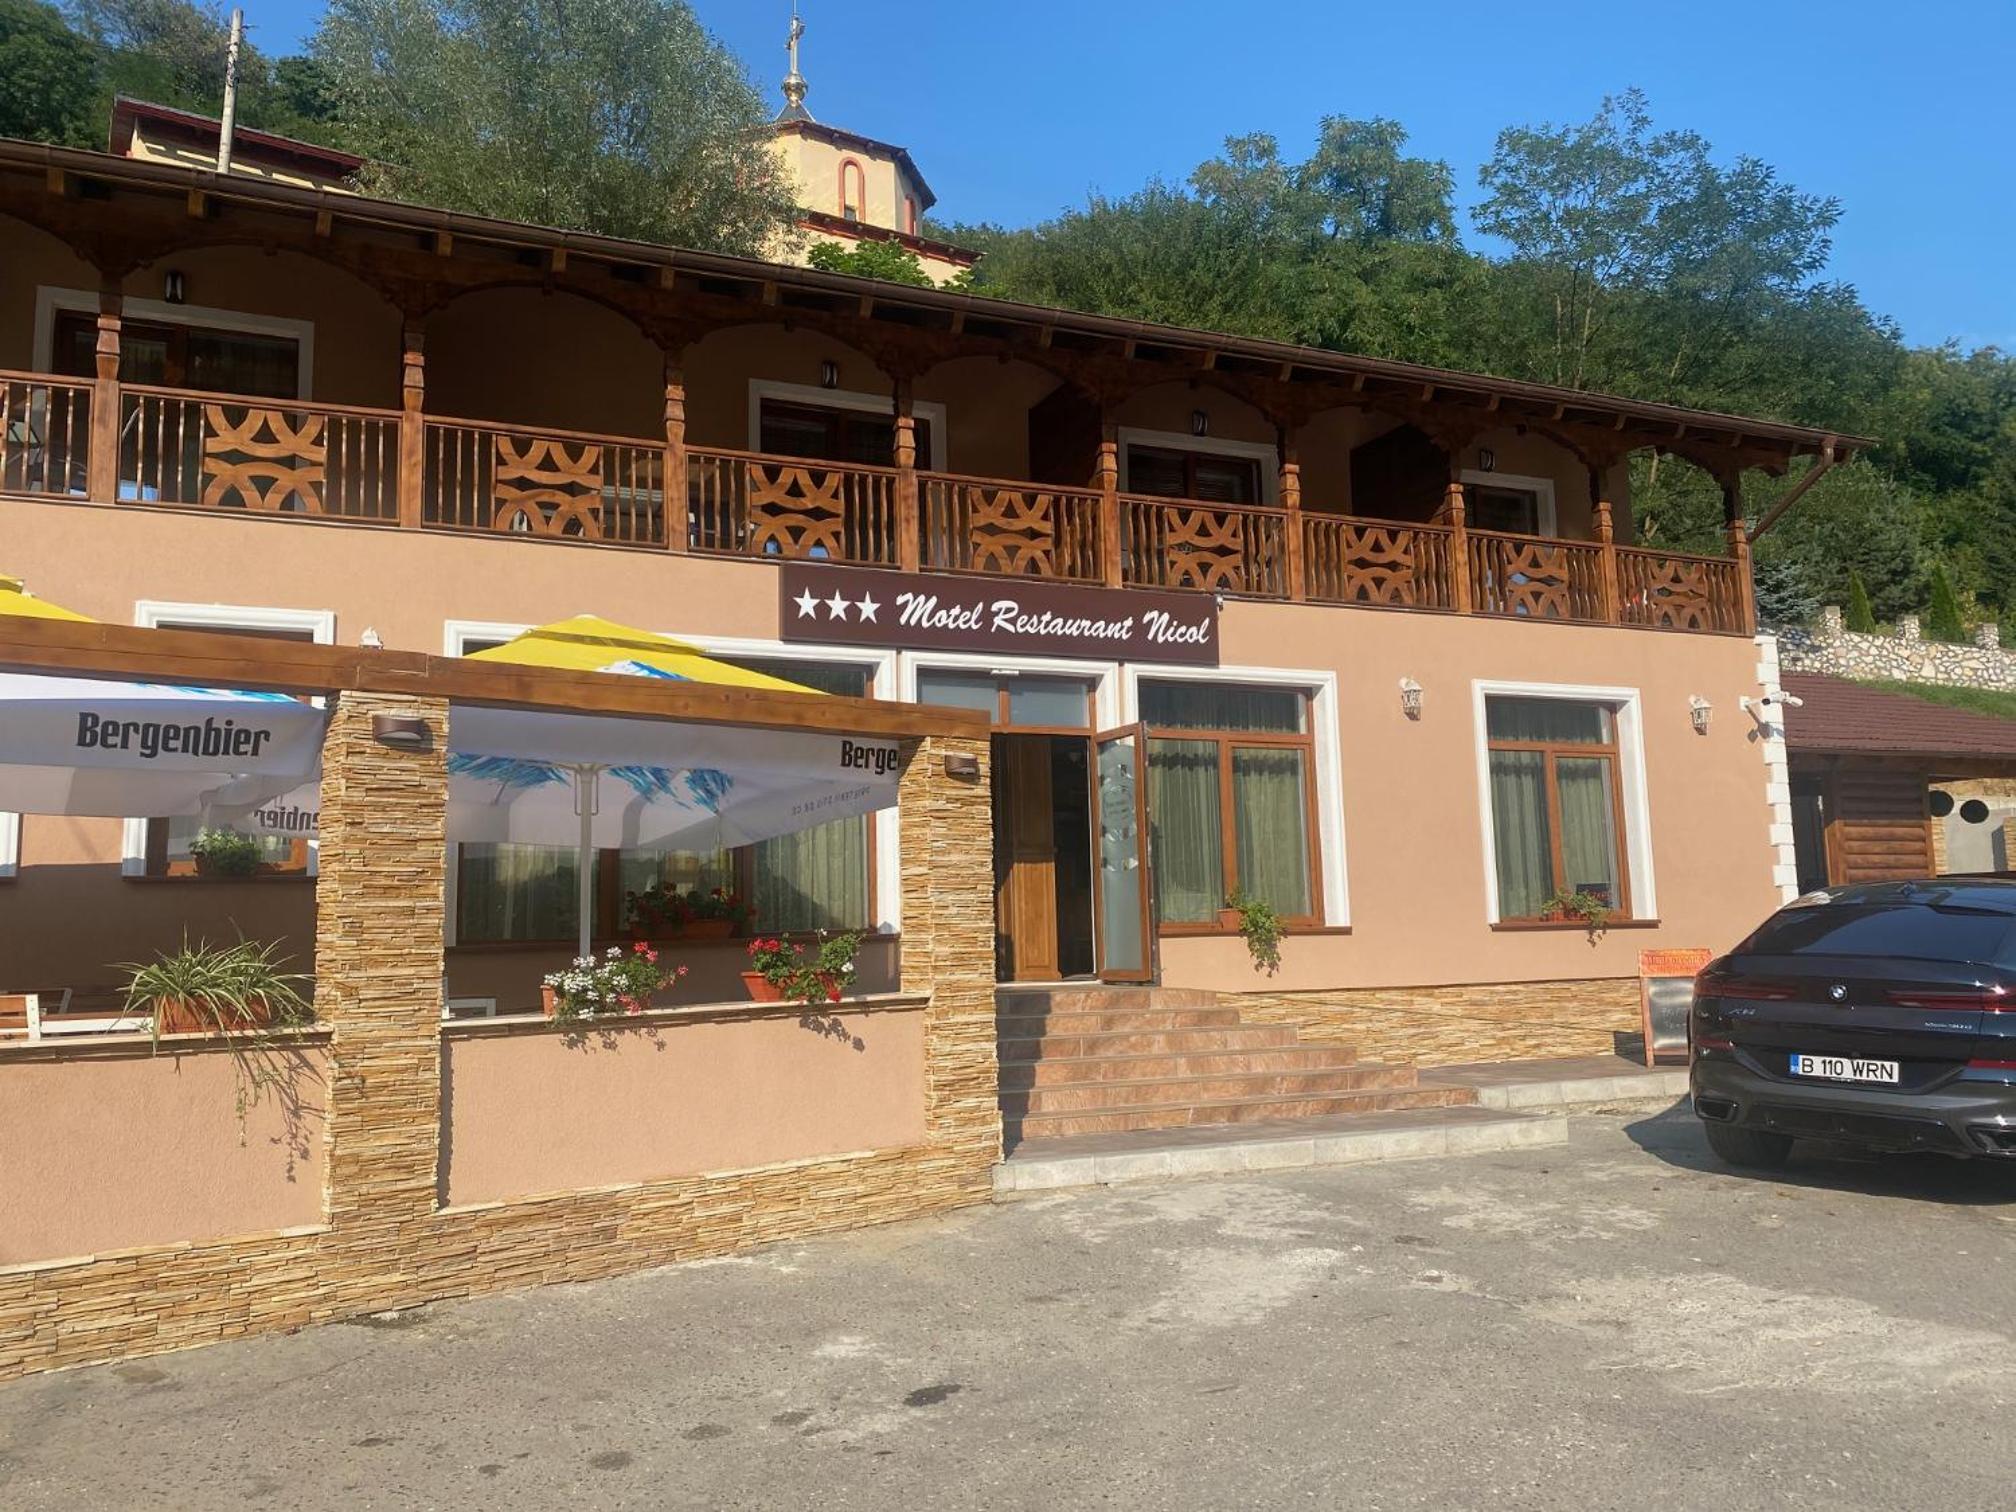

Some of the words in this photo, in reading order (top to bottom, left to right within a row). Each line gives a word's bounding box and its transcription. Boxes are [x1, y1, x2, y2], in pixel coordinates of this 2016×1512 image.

[896, 592, 983, 630] Motel
[990, 600, 1132, 641] Restaurant
[1142, 610, 1209, 645] Nicol
[77, 711, 270, 759] Bergenbier
[841, 740, 900, 775] Berge
[1801, 1057, 1814, 1074] B
[1821, 1058, 1844, 1076] 110
[1851, 1060, 1893, 1080] WRN
